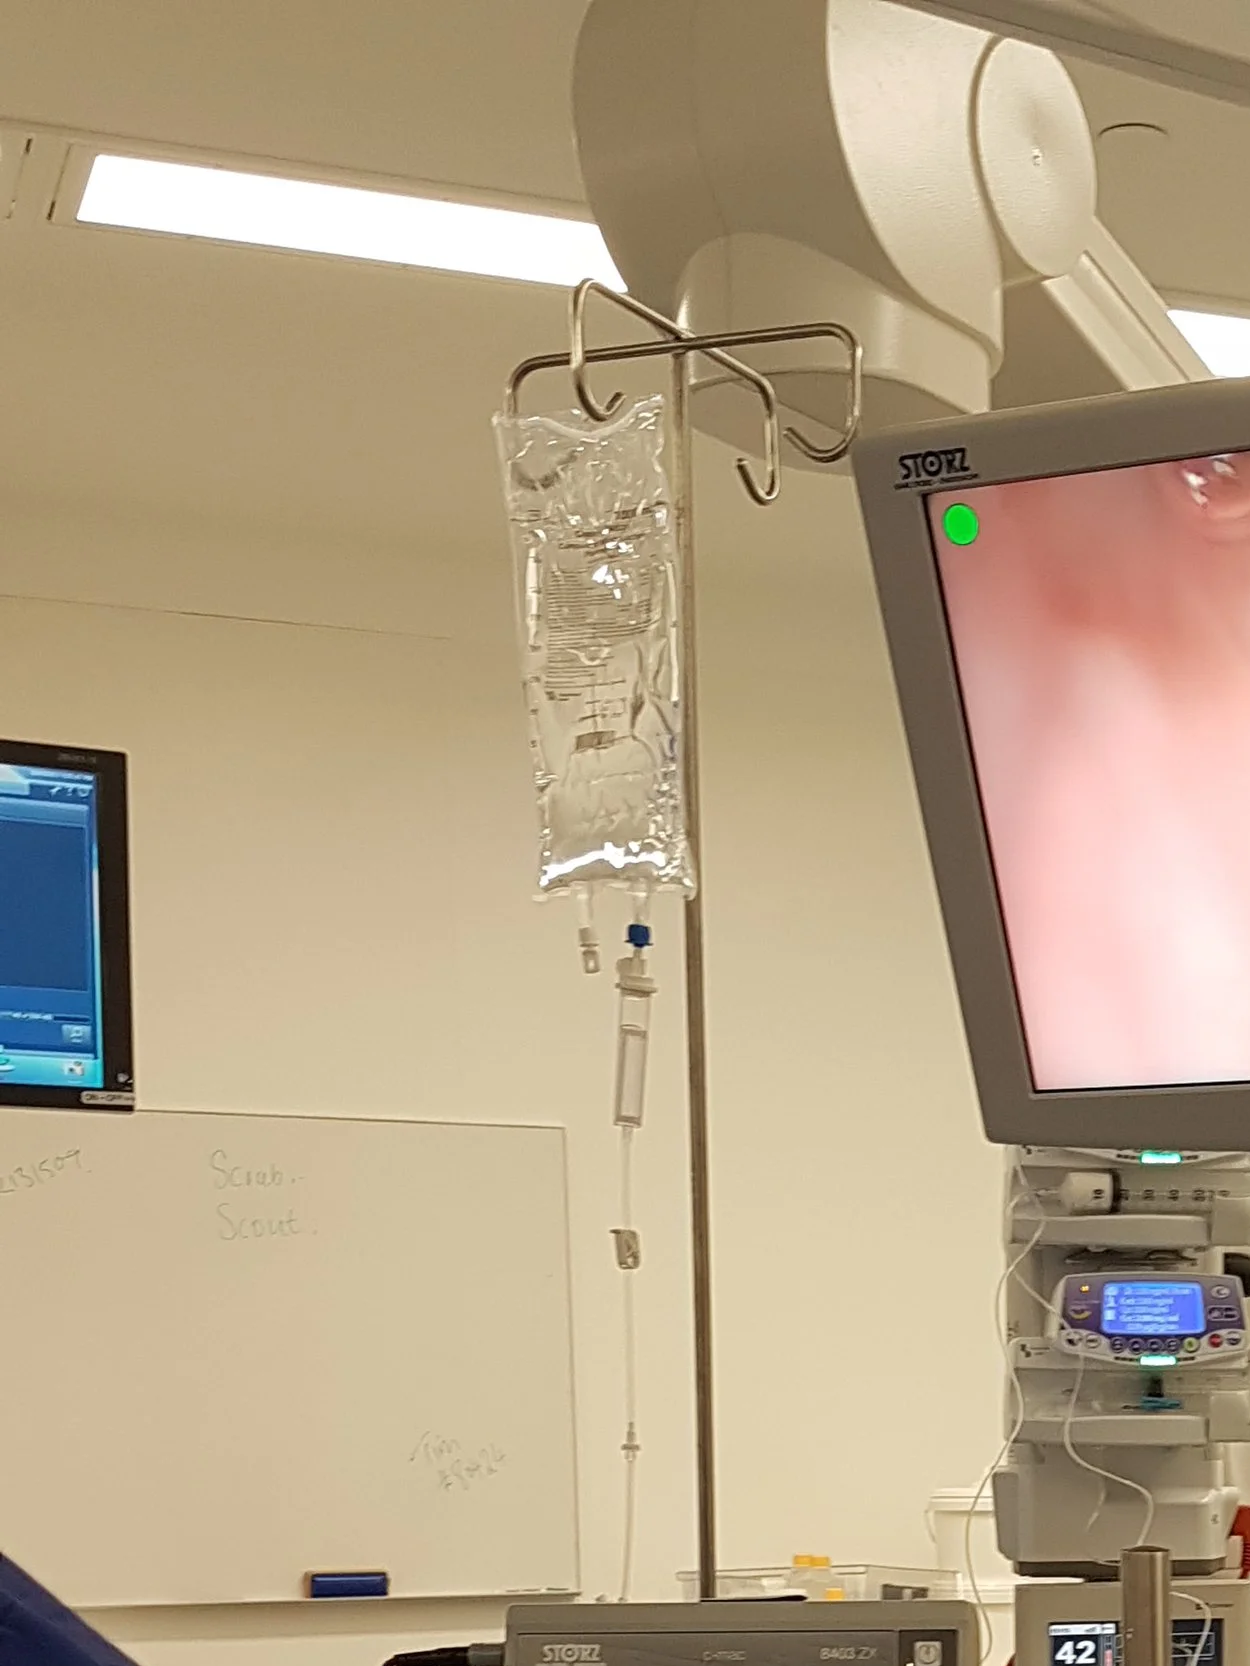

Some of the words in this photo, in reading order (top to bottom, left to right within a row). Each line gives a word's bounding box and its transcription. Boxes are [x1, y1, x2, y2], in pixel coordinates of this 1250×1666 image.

[898, 447, 971, 480] STORZ
[542, 1643, 601, 1662] STORZ
[1054, 1639, 1097, 1665] 42
